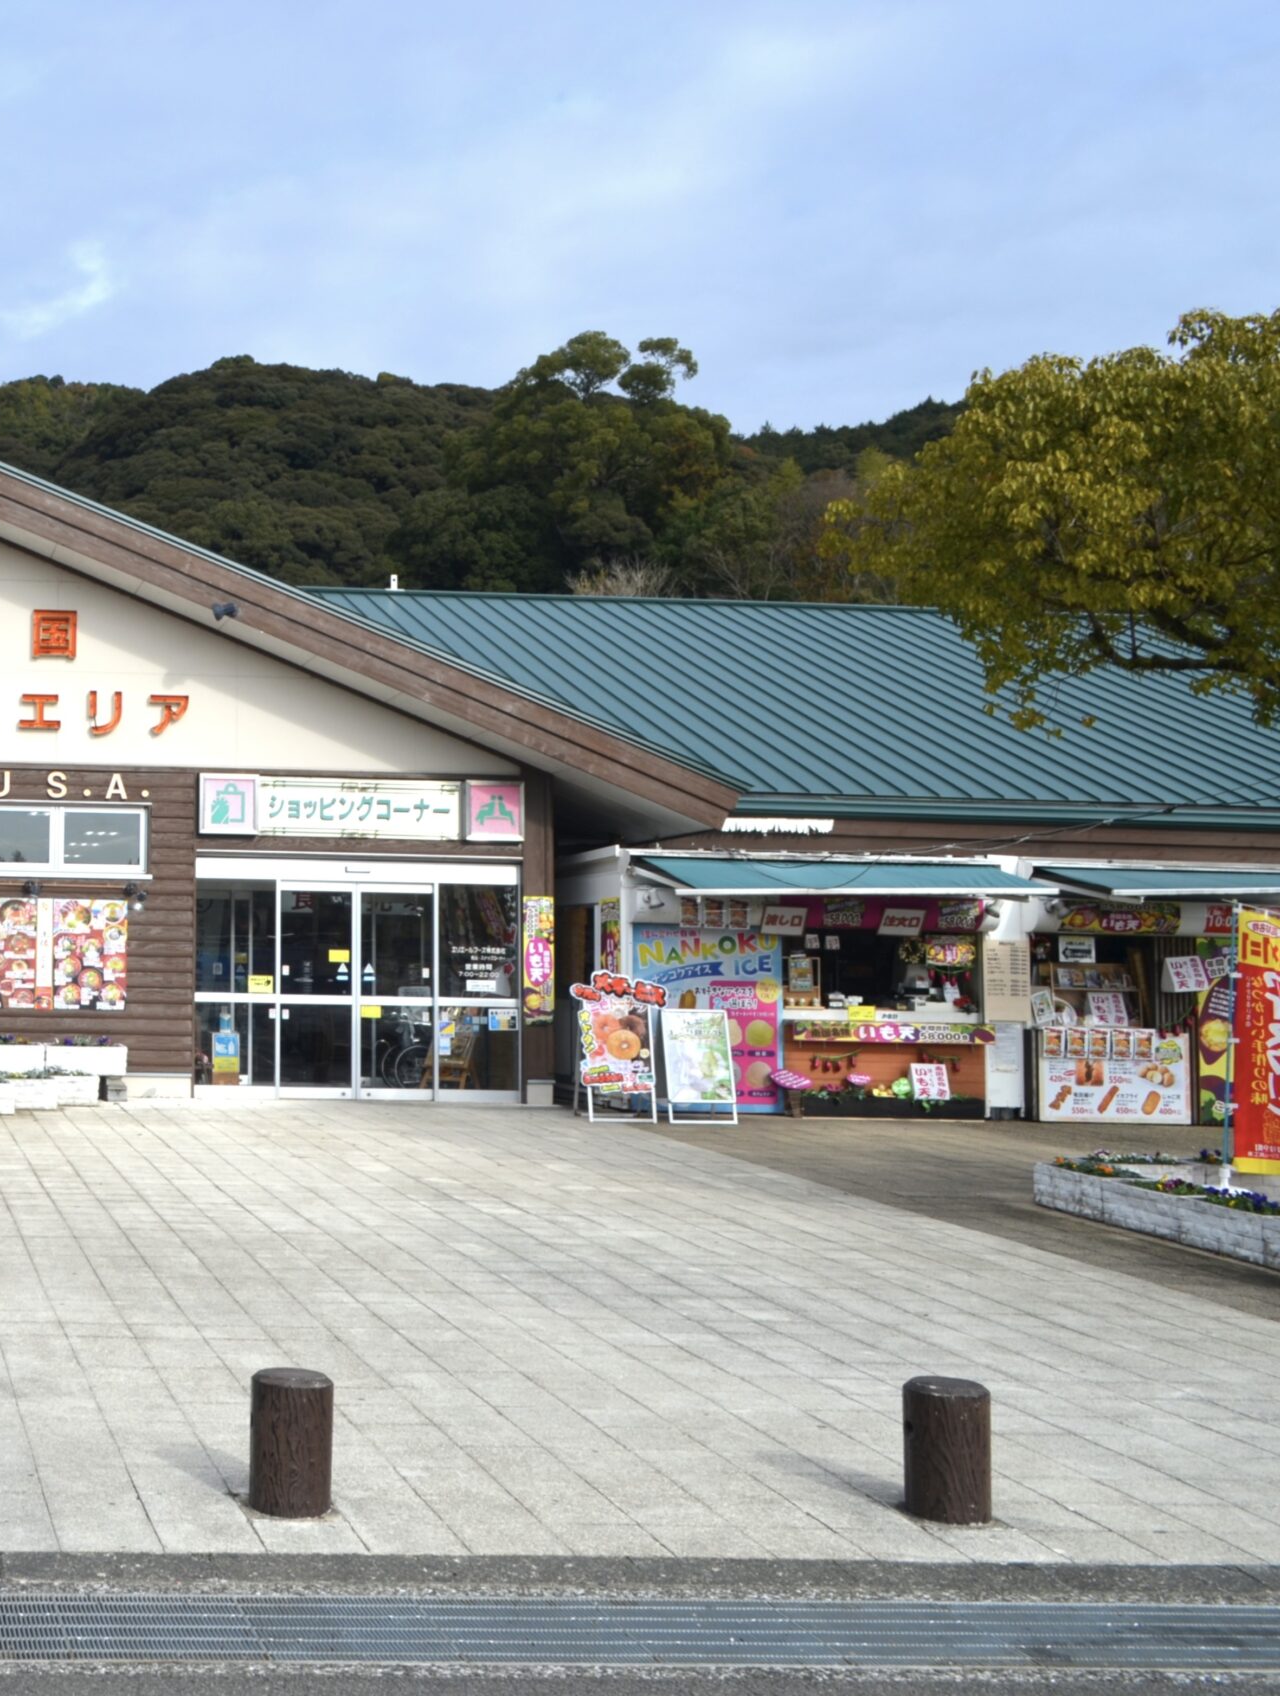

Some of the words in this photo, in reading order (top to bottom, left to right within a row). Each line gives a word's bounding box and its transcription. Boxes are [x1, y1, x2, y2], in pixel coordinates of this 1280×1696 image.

[267, 796, 451, 822] ショッピングコーナー
[637, 931, 778, 967] NANKOKU
[734, 954, 772, 976] ICE
[858, 1024, 915, 1041] いも天
